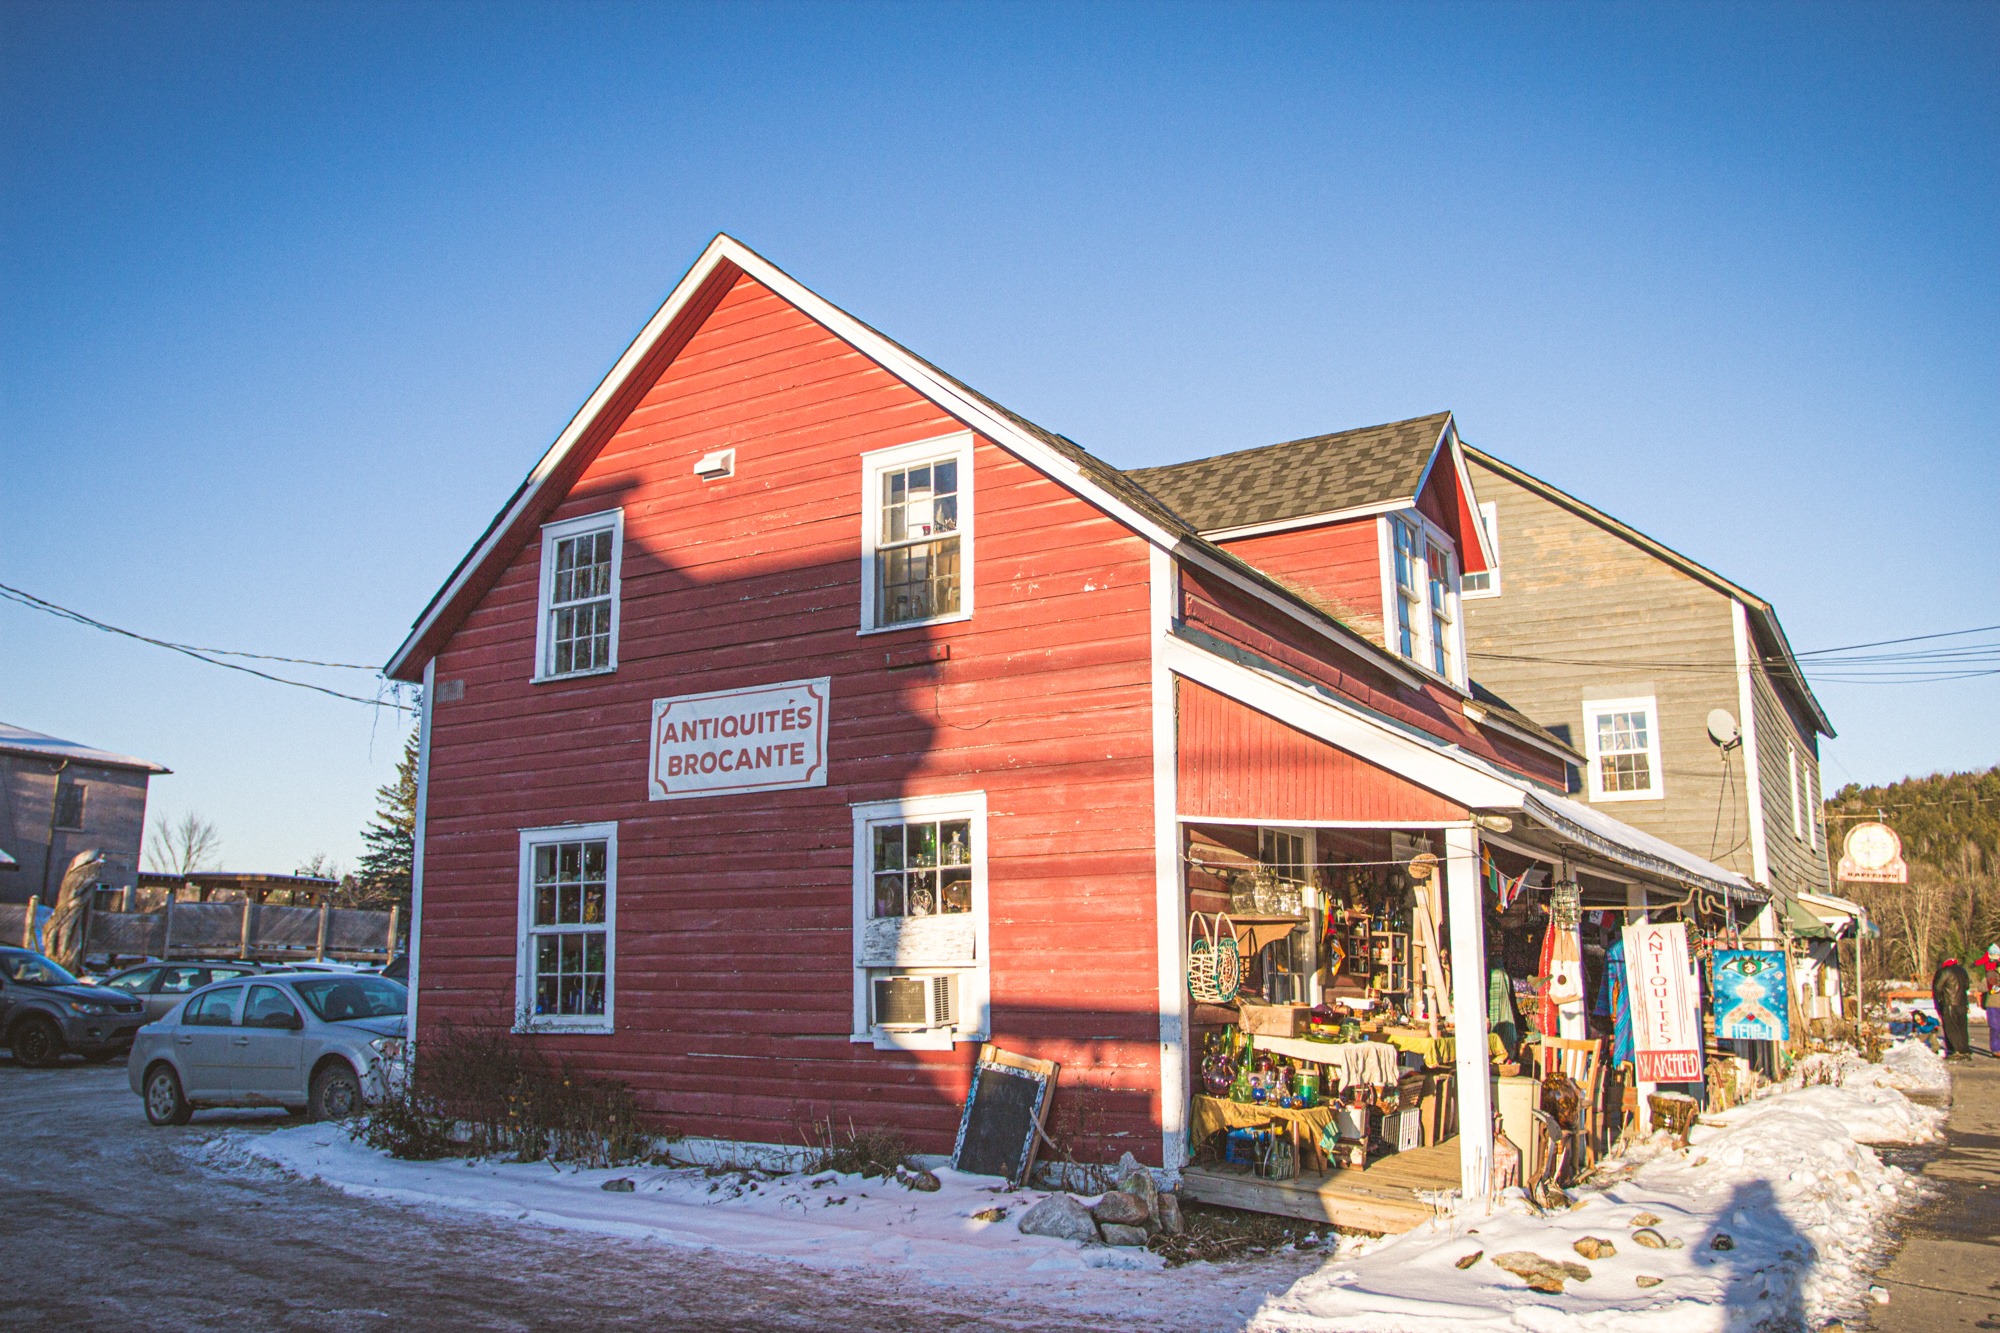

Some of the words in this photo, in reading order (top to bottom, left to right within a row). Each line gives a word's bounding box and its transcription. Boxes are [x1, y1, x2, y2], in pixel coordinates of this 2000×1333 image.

[662, 699, 812, 744] ANTIQUITÉS
[668, 742, 804, 776] BROCANTE
[1638, 1053, 1699, 1078] WAKEFIELD
